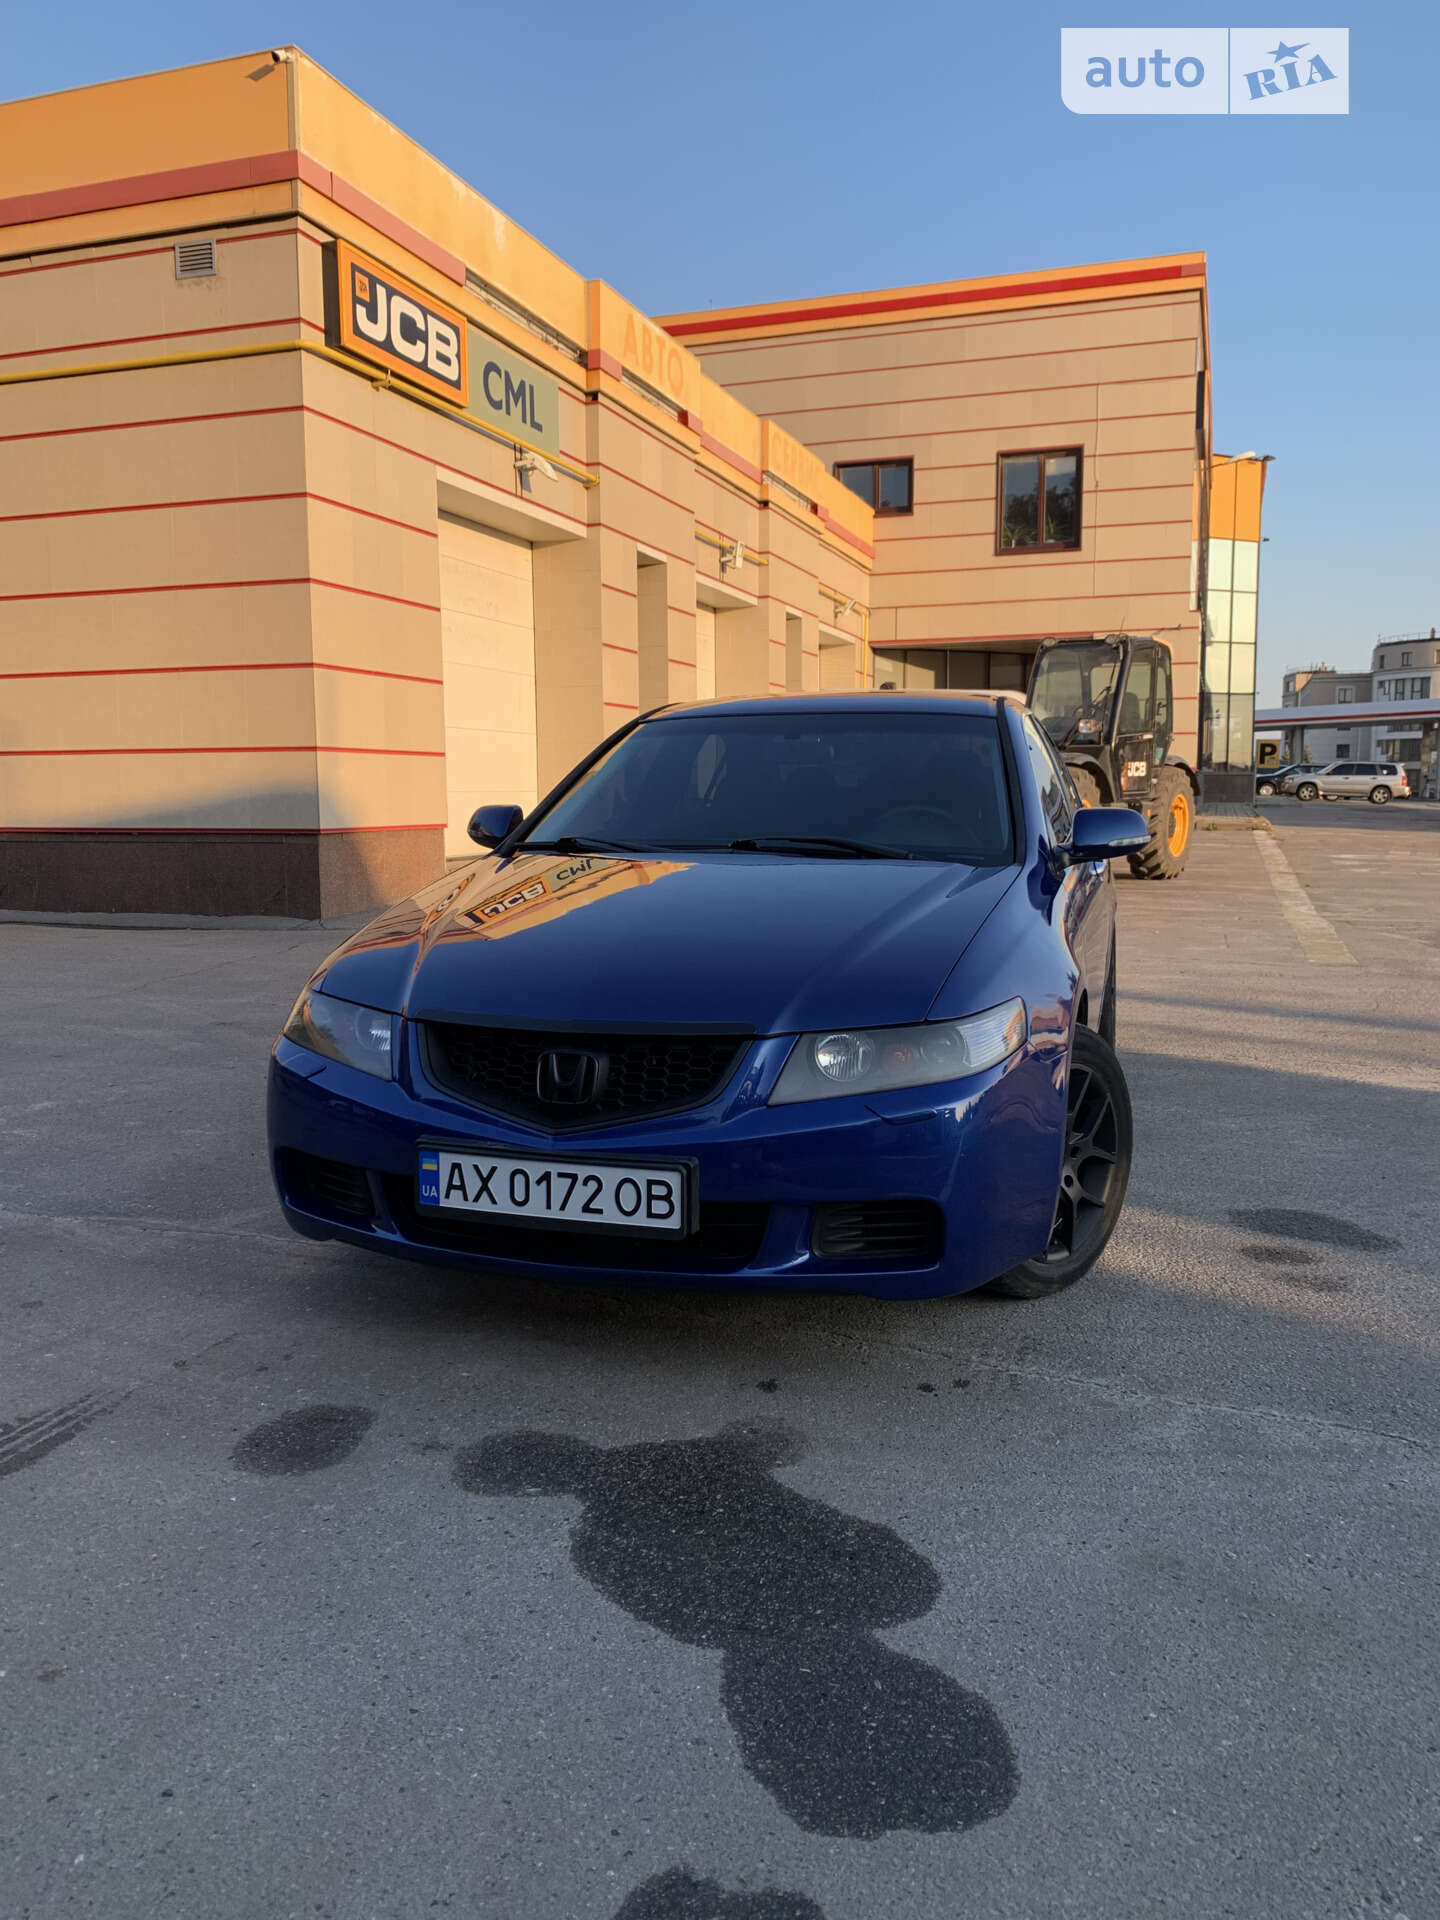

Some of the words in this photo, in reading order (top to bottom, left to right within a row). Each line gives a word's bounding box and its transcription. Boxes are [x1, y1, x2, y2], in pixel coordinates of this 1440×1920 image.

[355, 283, 459, 382] JCB
[483, 361, 543, 433] CML
[1127, 761, 1147, 777] JCB
[1259, 743, 1277, 764] P
[422, 1184, 438, 1198] UA
[444, 1162, 498, 1205] AX
[508, 1168, 604, 1215] 0172
[615, 1177, 676, 1220] OB
